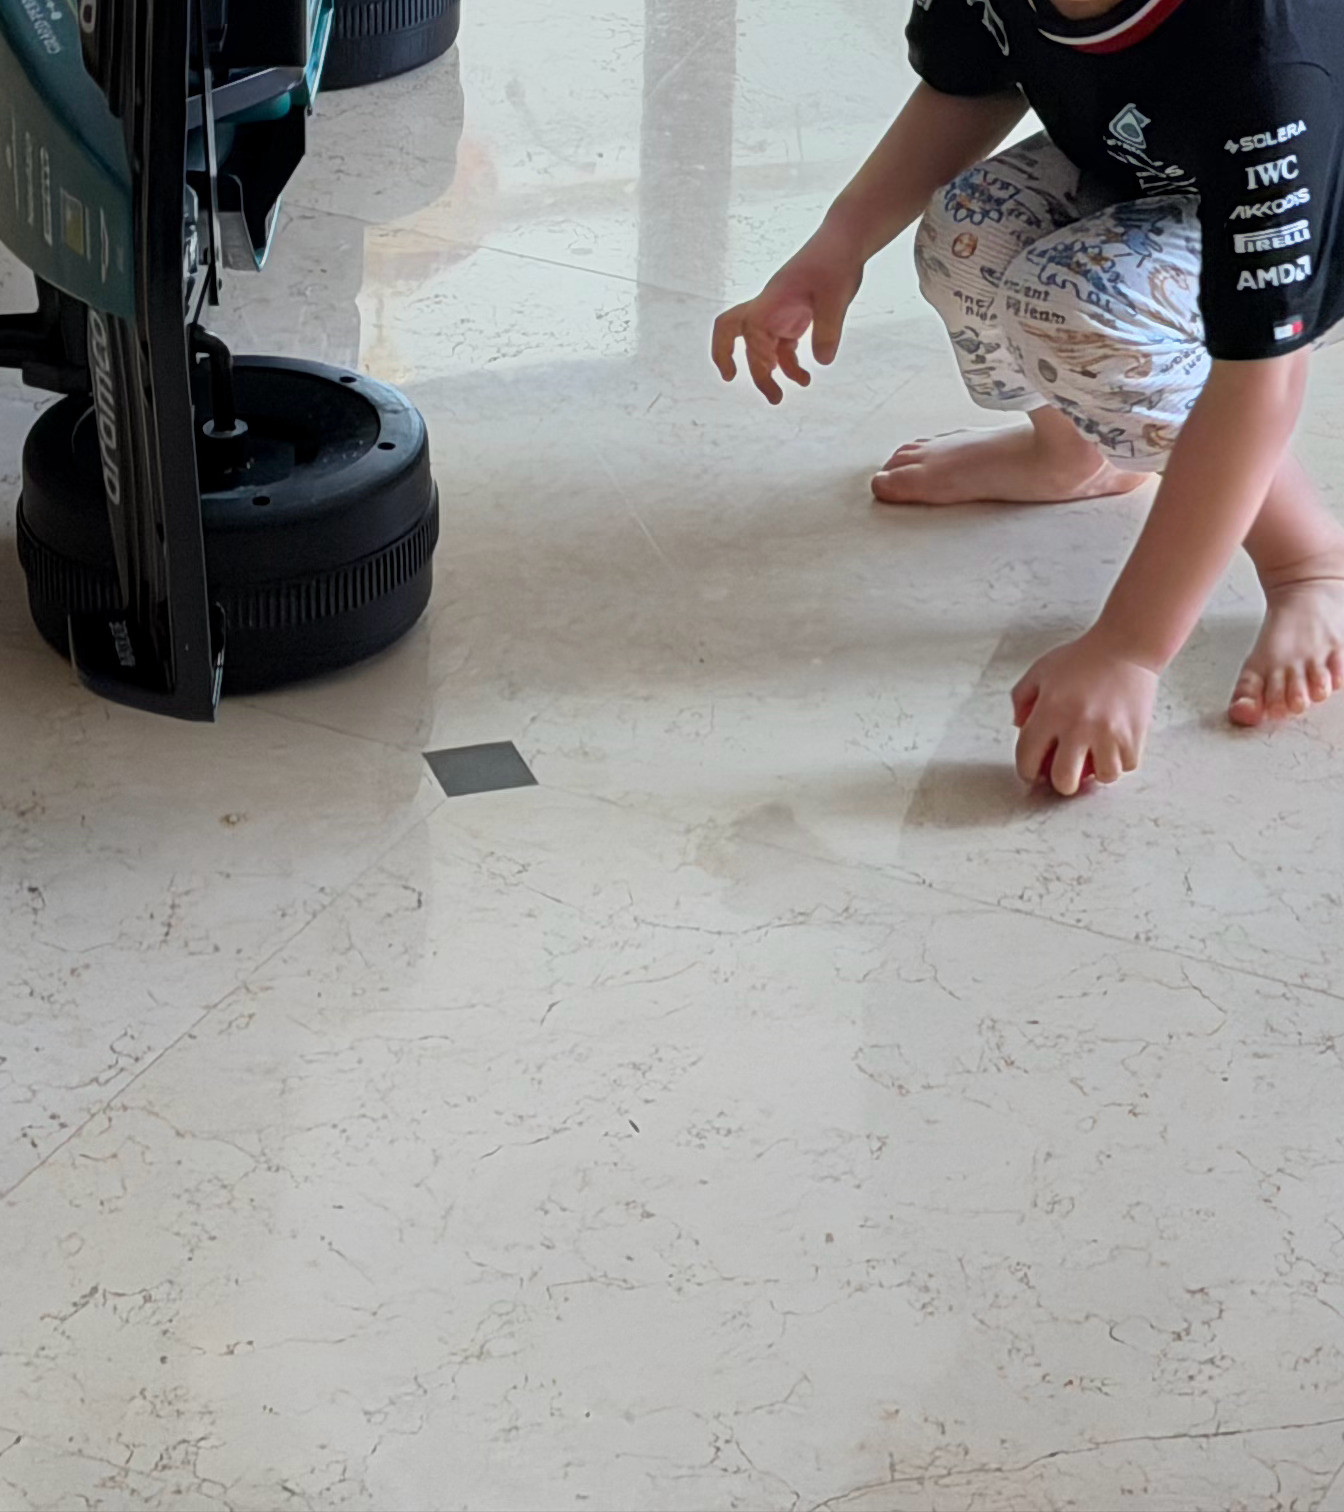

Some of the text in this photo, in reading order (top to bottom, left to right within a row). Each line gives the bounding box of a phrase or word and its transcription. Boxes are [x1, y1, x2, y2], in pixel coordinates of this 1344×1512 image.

[1238, 119, 1307, 153] SOLERA
[1244, 154, 1300, 191] IWC
[1232, 218, 1312, 254] PIRELLI
[1235, 261, 1298, 291] AMD
